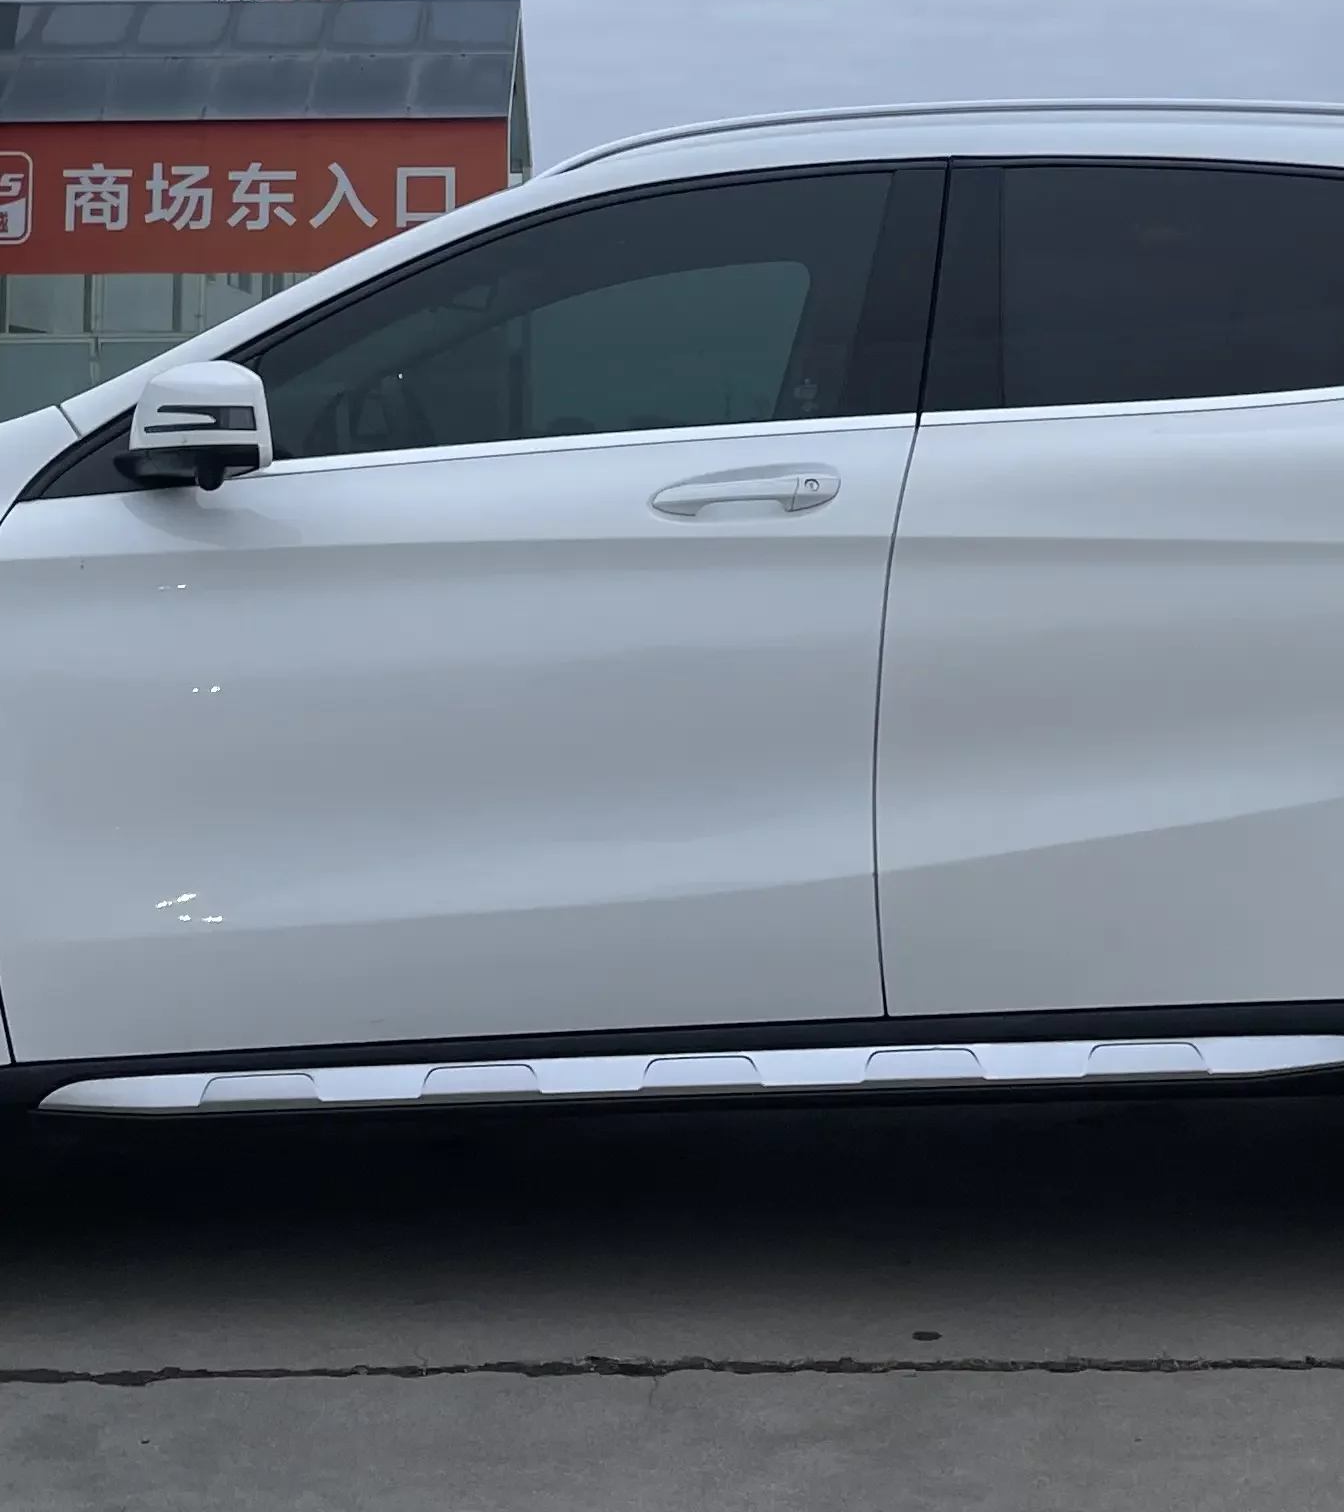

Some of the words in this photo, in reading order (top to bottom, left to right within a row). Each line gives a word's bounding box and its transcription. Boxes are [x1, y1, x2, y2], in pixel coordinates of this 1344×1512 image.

[62, 162, 457, 232] 商场东入口
